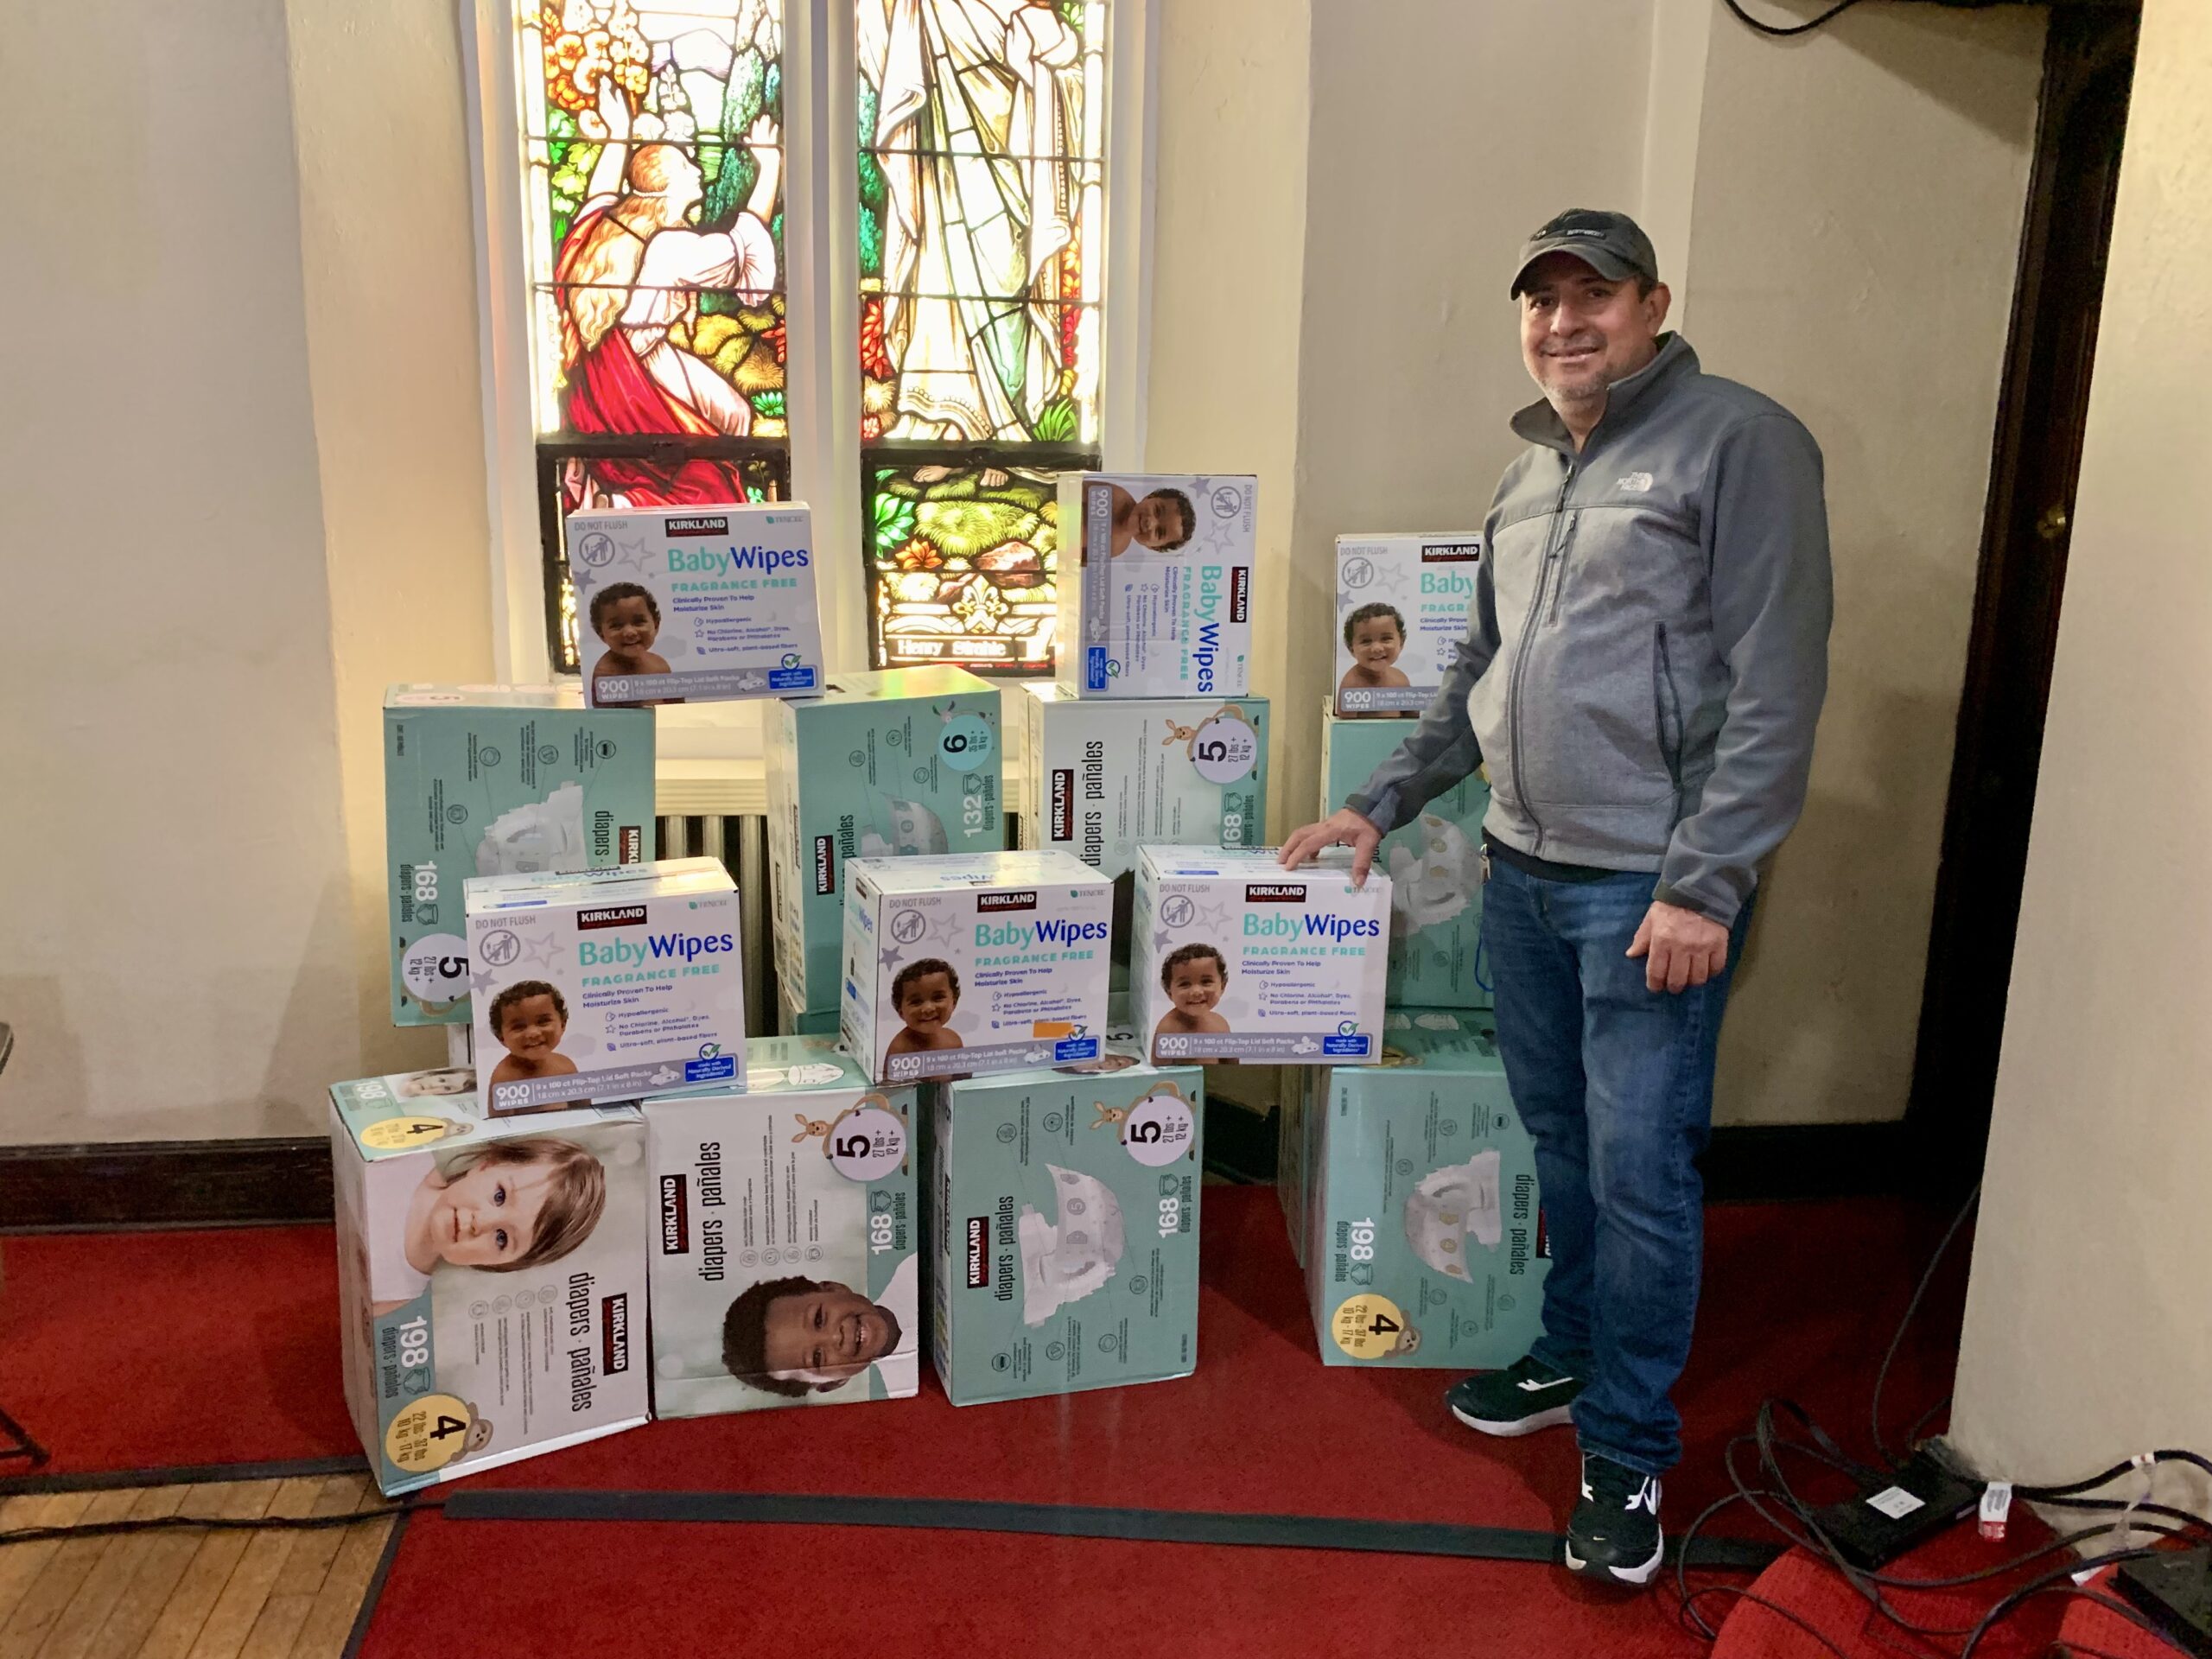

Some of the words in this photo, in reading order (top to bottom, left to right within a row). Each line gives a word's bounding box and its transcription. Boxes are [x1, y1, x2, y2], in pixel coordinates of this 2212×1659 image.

[1245, 485, 1252, 494] DO
[1097, 489, 1108, 517] 900
[575, 522, 586, 531] DO
[588, 521, 604, 531] NOT
[606, 520, 627, 529] FLUSH
[669, 519, 726, 531] KIRKLAND
[1368, 546, 1388, 555] FLUSH
[1425, 547, 1478, 556] KIRKLAND
[671, 580, 757, 593] FRAGRANCE
[763, 578, 797, 588] FREE
[1237, 570, 1246, 620] KIRKLAND
[1181, 567, 1191, 644] FRAGRANCE
[1180, 649, 1189, 680] FREE
[599, 680, 629, 692] 900
[1344, 692, 1370, 702] 900
[944, 734, 967, 753] 6
[1198, 741, 1227, 762] 5
[1229, 744, 1239, 753] lbs
[1082, 741, 1105, 799] pañales
[963, 795, 982, 837] 132
[1053, 772, 1065, 837] KIRKLAND
[592, 811, 613, 855] diapers
[837, 815, 857, 858] pañales
[1080, 811, 1101, 866] diapers
[628, 830, 639, 864] KIRKL
[817, 838, 828, 892] KIRKLAND
[399, 864, 414, 891] diapers
[415, 861, 438, 901] 168
[889, 899, 900, 908] DO
[902, 898, 918, 907] NOT
[919, 897, 941, 906] FLUSH
[981, 893, 1034, 906] KIRKLAND
[1249, 887, 1304, 895] KIRKLAND
[476, 920, 490, 929] DO
[492, 918, 508, 928] NOT
[510, 915, 536, 926] FLUSH
[582, 909, 645, 922] KIRKLAND
[975, 953, 1057, 967] FRAGRANCE
[1062, 950, 1093, 960] FREE
[1243, 947, 1326, 956] FRAGRANCE
[1332, 947, 1365, 956] FREE
[439, 957, 469, 978] 5
[582, 969, 676, 988] FRAGRANCE
[682, 964, 720, 976] FREE
[582, 990, 614, 1000] Clinically
[583, 999, 621, 1008] Moisturize
[1160, 1038, 1188, 1049] 900
[892, 1057, 920, 1070] 900
[356, 1081, 387, 1099] 198
[496, 1084, 530, 1099] 900
[499, 1098, 529, 1107] WIPES
[406, 1124, 443, 1134] 4
[1131, 1121, 1161, 1143] 5
[1163, 1123, 1174, 1133] lbs
[1176, 1123, 1188, 1132] kg
[836, 1135, 870, 1158] 5
[873, 1137, 885, 1147] lbs
[887, 1137, 900, 1146] kg
[873, 1149, 885, 1158] 27
[695, 1141, 727, 1206] pañales
[1512, 1174, 1535, 1219] diapers
[664, 1178, 678, 1250] KIRKLAND
[994, 1196, 1014, 1245] pañales
[1159, 1198, 1179, 1238] 168
[871, 1213, 893, 1255] 168
[893, 1224, 907, 1250] diapers
[1335, 1221, 1351, 1249] diapers
[1351, 1217, 1375, 1261] 198
[699, 1220, 724, 1281] diapers
[969, 1219, 980, 1285] KIRKLAND
[1510, 1229, 1529, 1275] pañales
[994, 1249, 1014, 1301] diapers
[566, 1273, 594, 1336] diapers
[613, 1298, 625, 1370] KIRKLAND
[1369, 1314, 1399, 1335] 4
[383, 1327, 398, 1360] diapers
[400, 1316, 429, 1368] 198
[567, 1347, 597, 1412] pañales
[430, 1416, 466, 1440] 4
